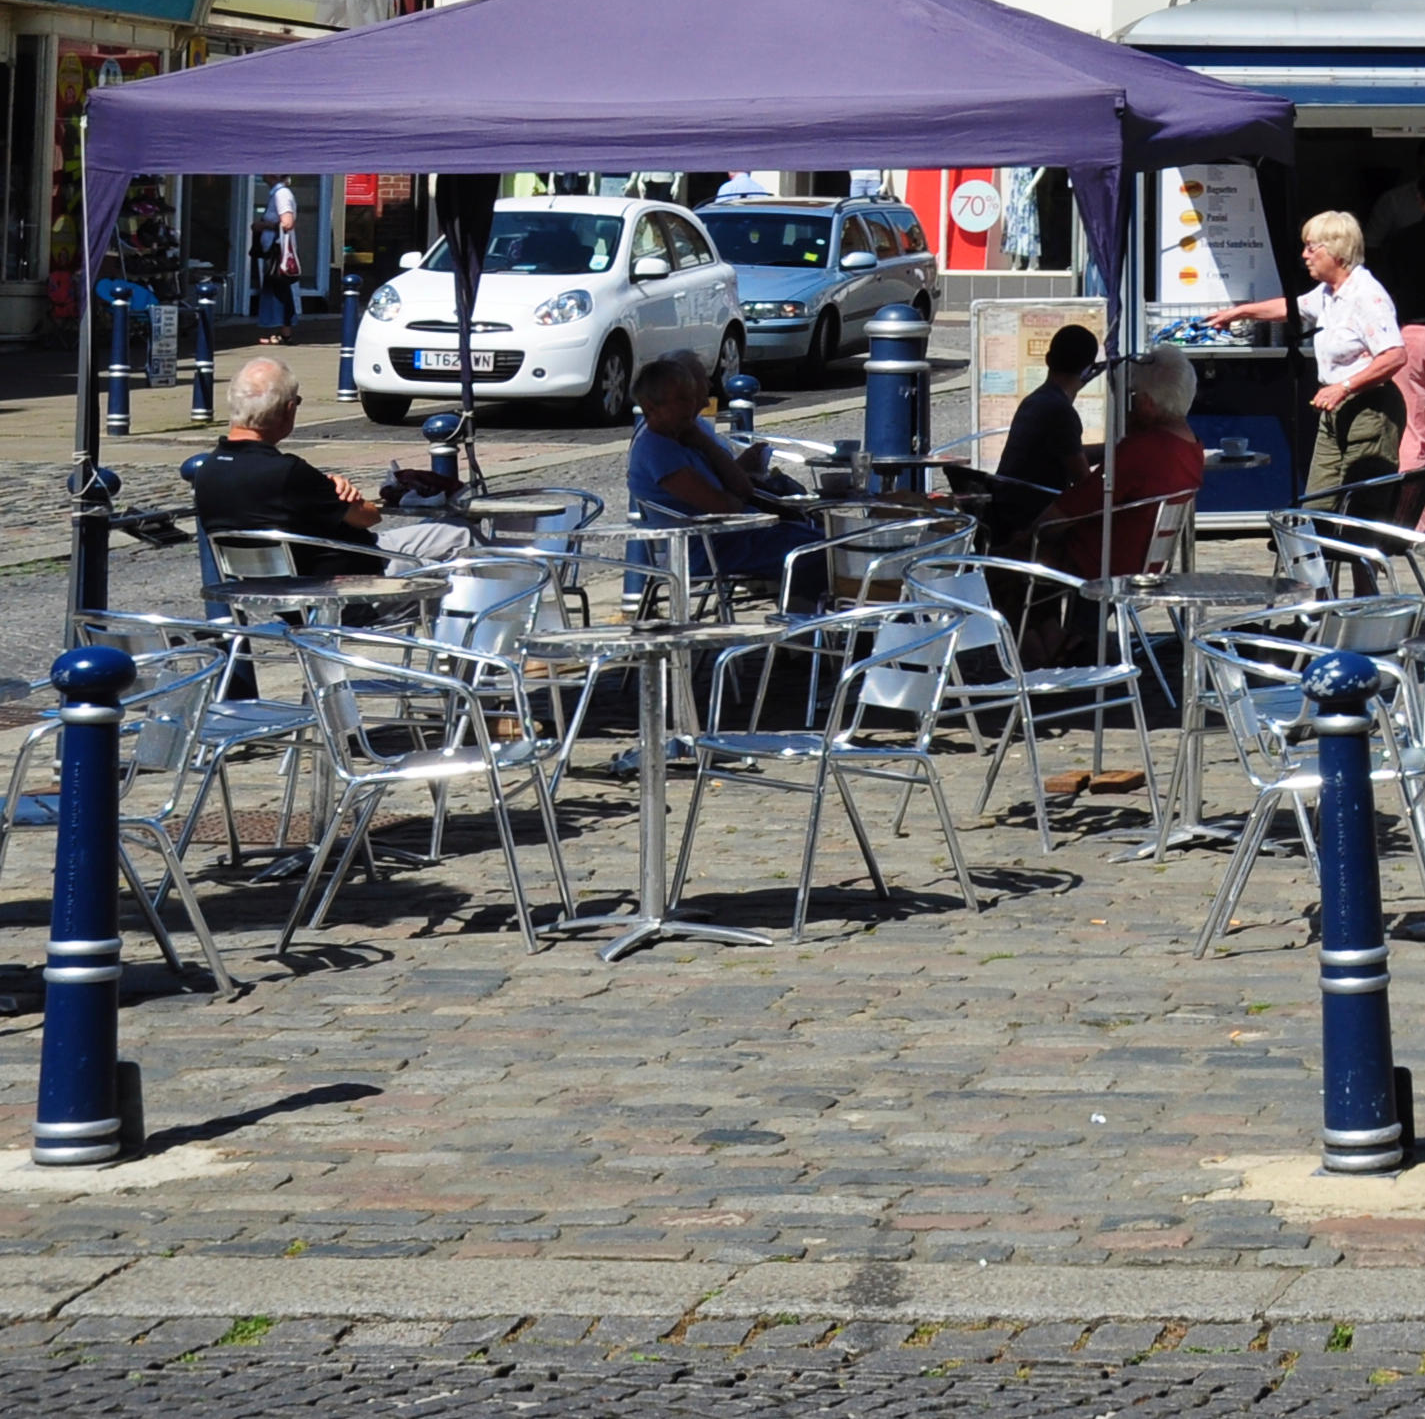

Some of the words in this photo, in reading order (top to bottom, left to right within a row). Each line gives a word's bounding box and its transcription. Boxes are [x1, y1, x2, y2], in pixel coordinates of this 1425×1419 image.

[957, 195, 999, 216] 70%
[423, 353, 460, 367] LT62
[472, 355, 493, 368] WN
